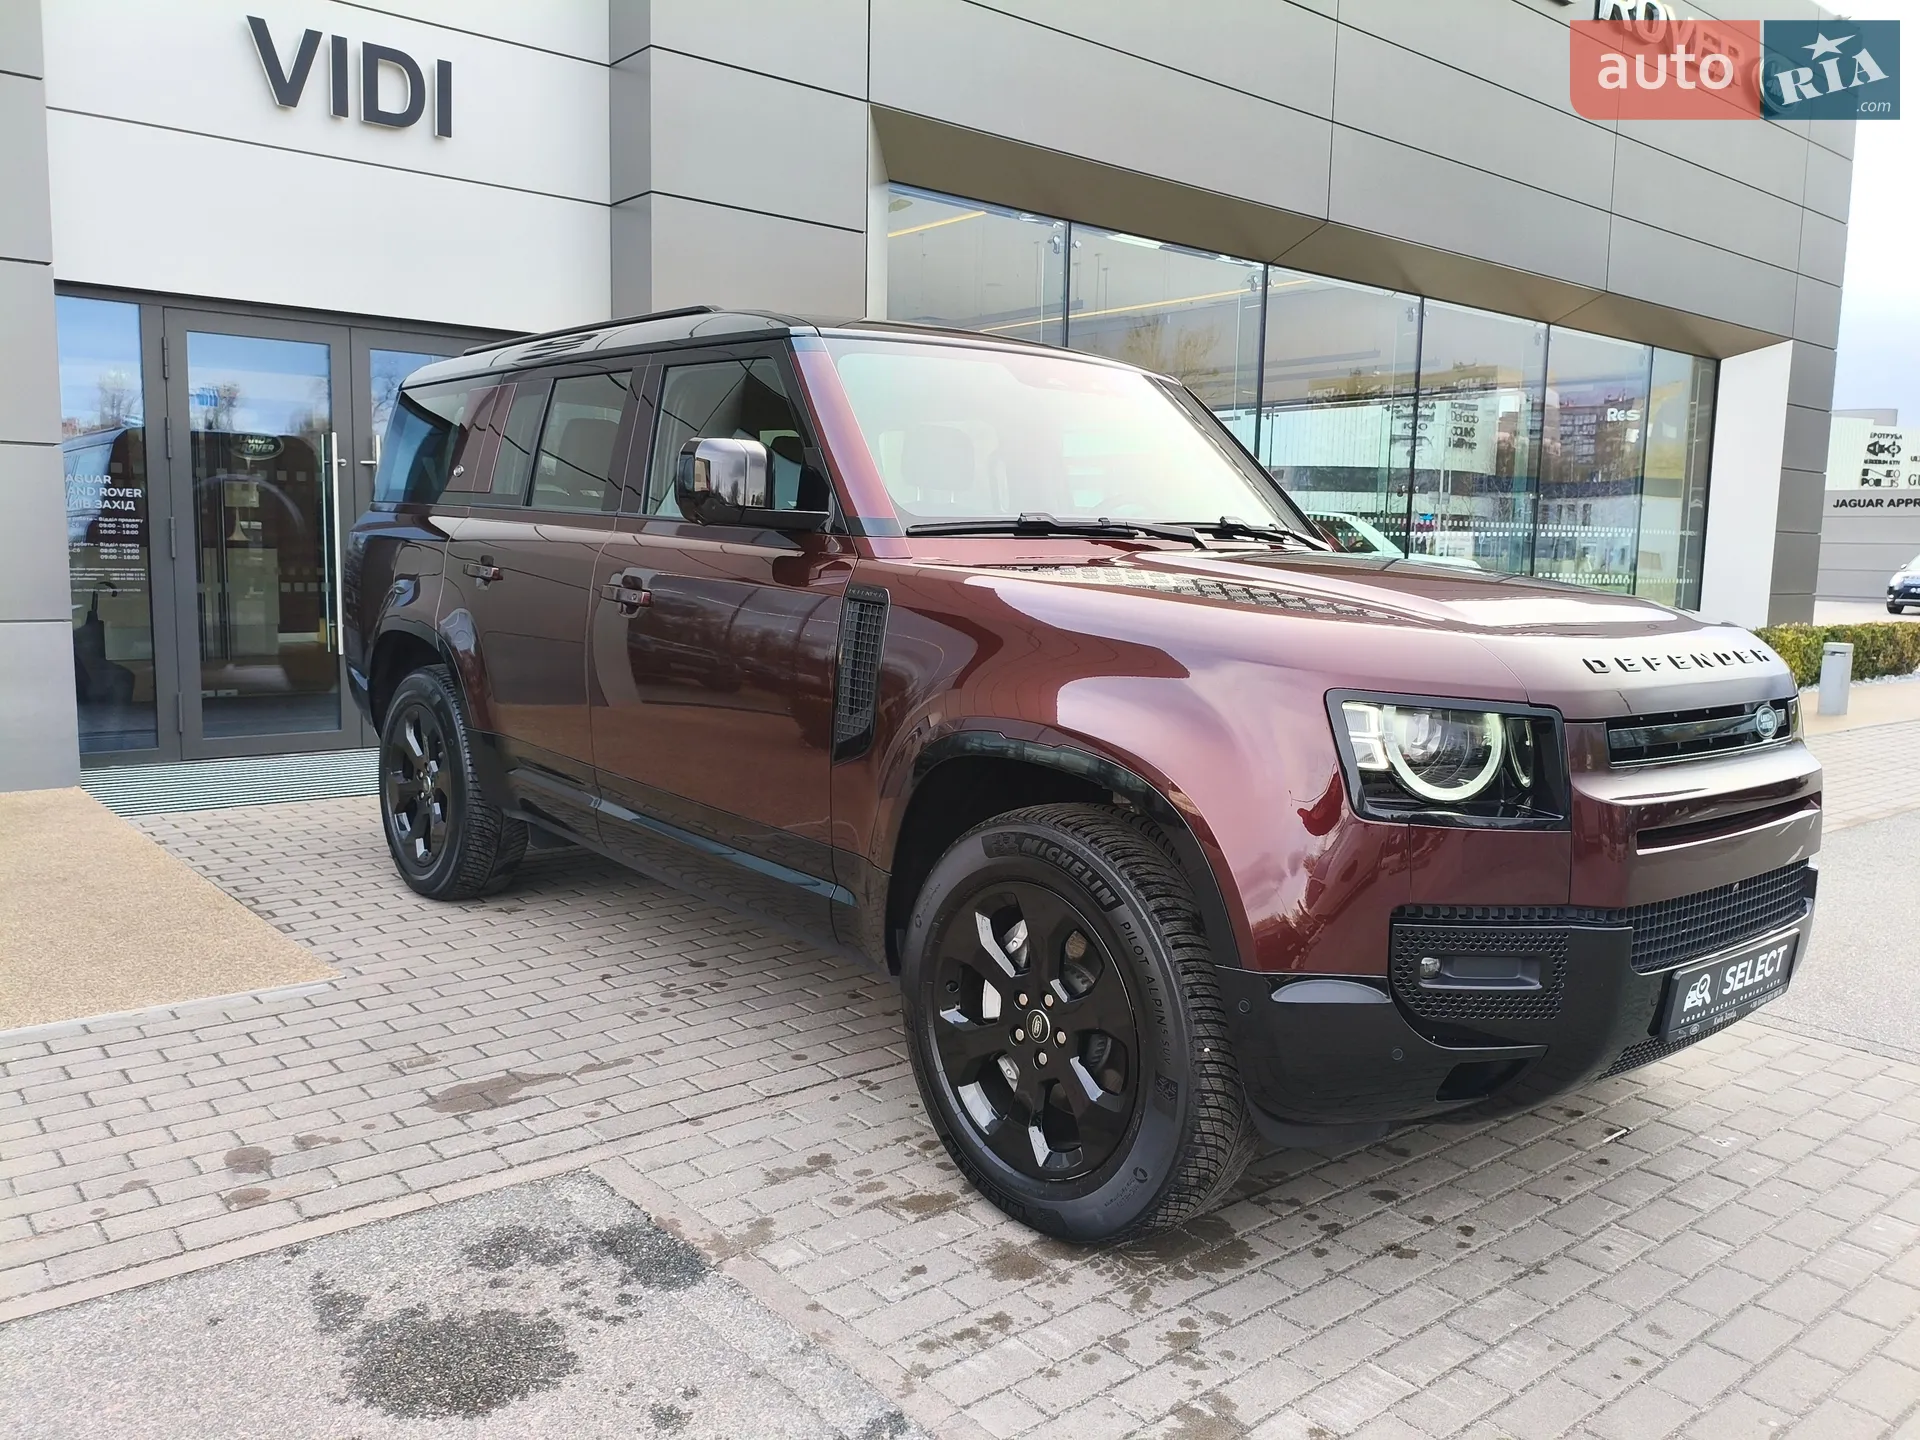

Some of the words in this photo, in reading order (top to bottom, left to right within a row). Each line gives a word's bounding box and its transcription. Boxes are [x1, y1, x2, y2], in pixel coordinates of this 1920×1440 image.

[246, 15, 453, 139] VIDI
[240, 444, 275, 453] ROVER
[65, 474, 112, 484] AGUAR
[67, 486, 96, 496] AND
[99, 488, 142, 498] ROVER
[95, 499, 136, 511] ЗАХІД
[1832, 498, 1884, 508] JAGUAR
[1582, 649, 1771, 674] DEFENDER
[1021, 838, 1115, 906] MICHELIN
[1722, 944, 1788, 995] SELECT
[1119, 921, 1150, 965] PILOT
[1161, 1040, 1171, 1065] SUV
